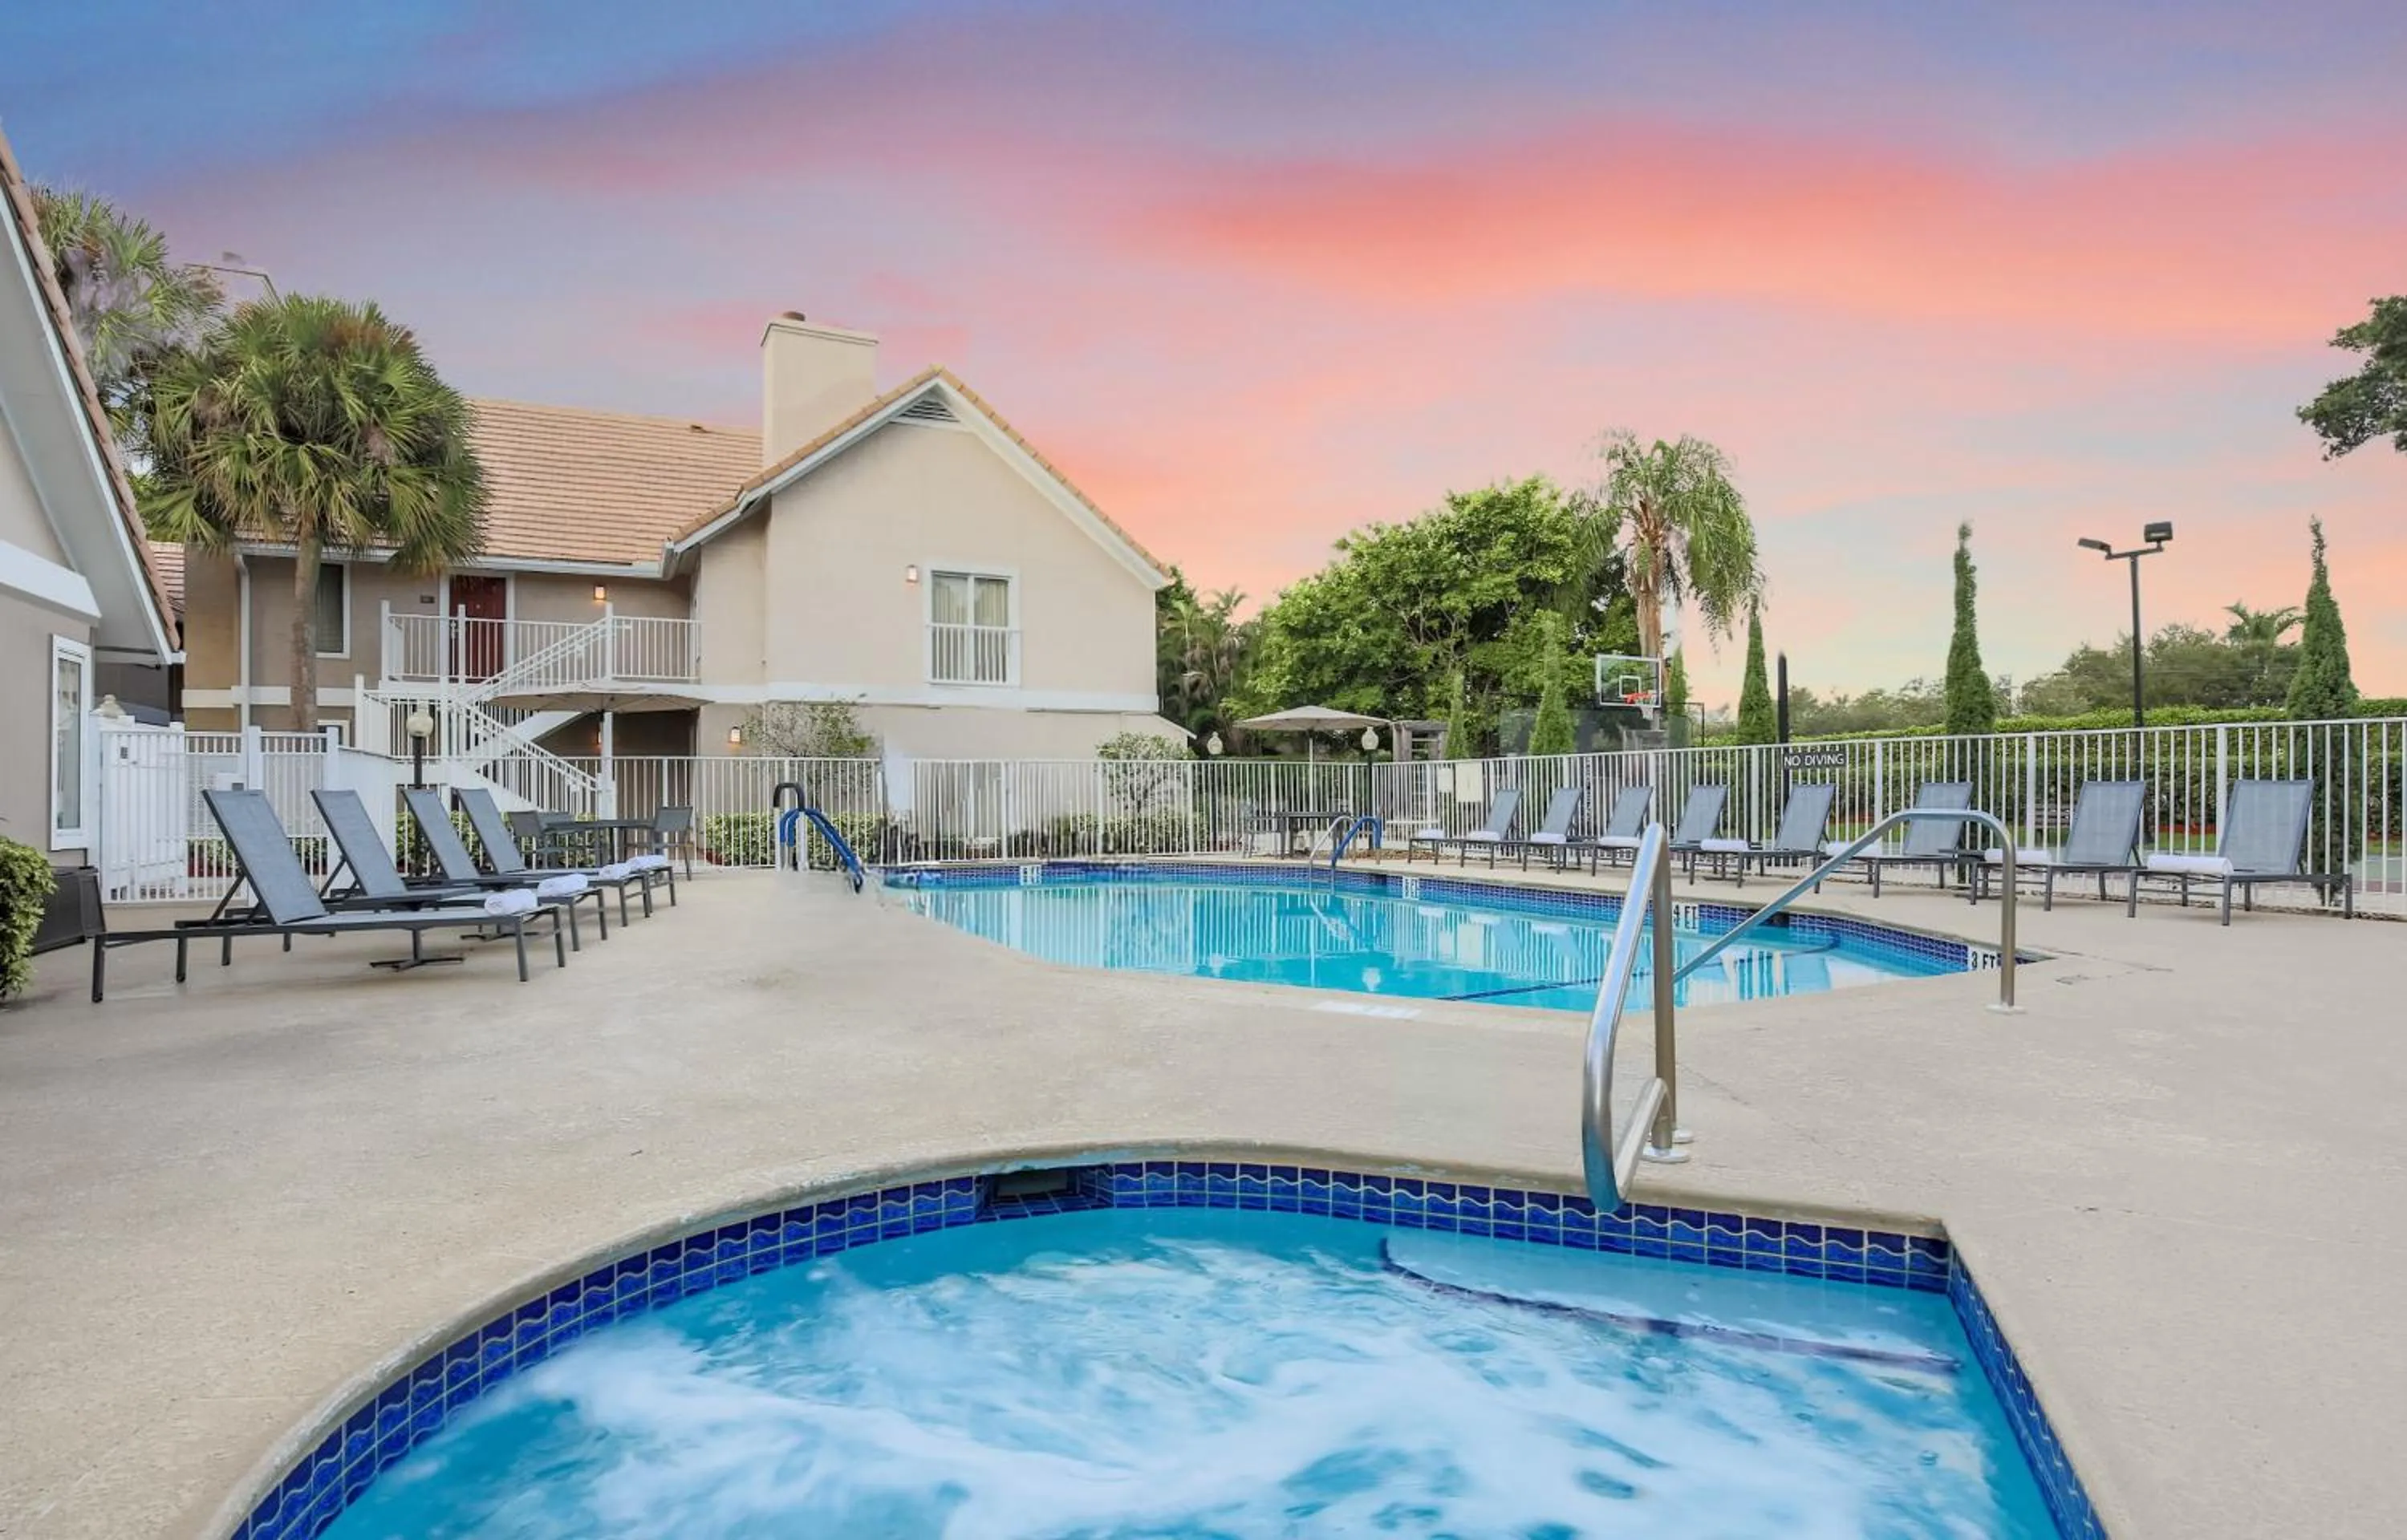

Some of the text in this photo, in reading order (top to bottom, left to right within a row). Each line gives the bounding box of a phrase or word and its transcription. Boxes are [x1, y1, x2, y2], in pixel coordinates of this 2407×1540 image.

[1784, 754, 1845, 766] NO DIVING
[1684, 906, 1697, 918] FT
[1983, 954, 1995, 969] FT
